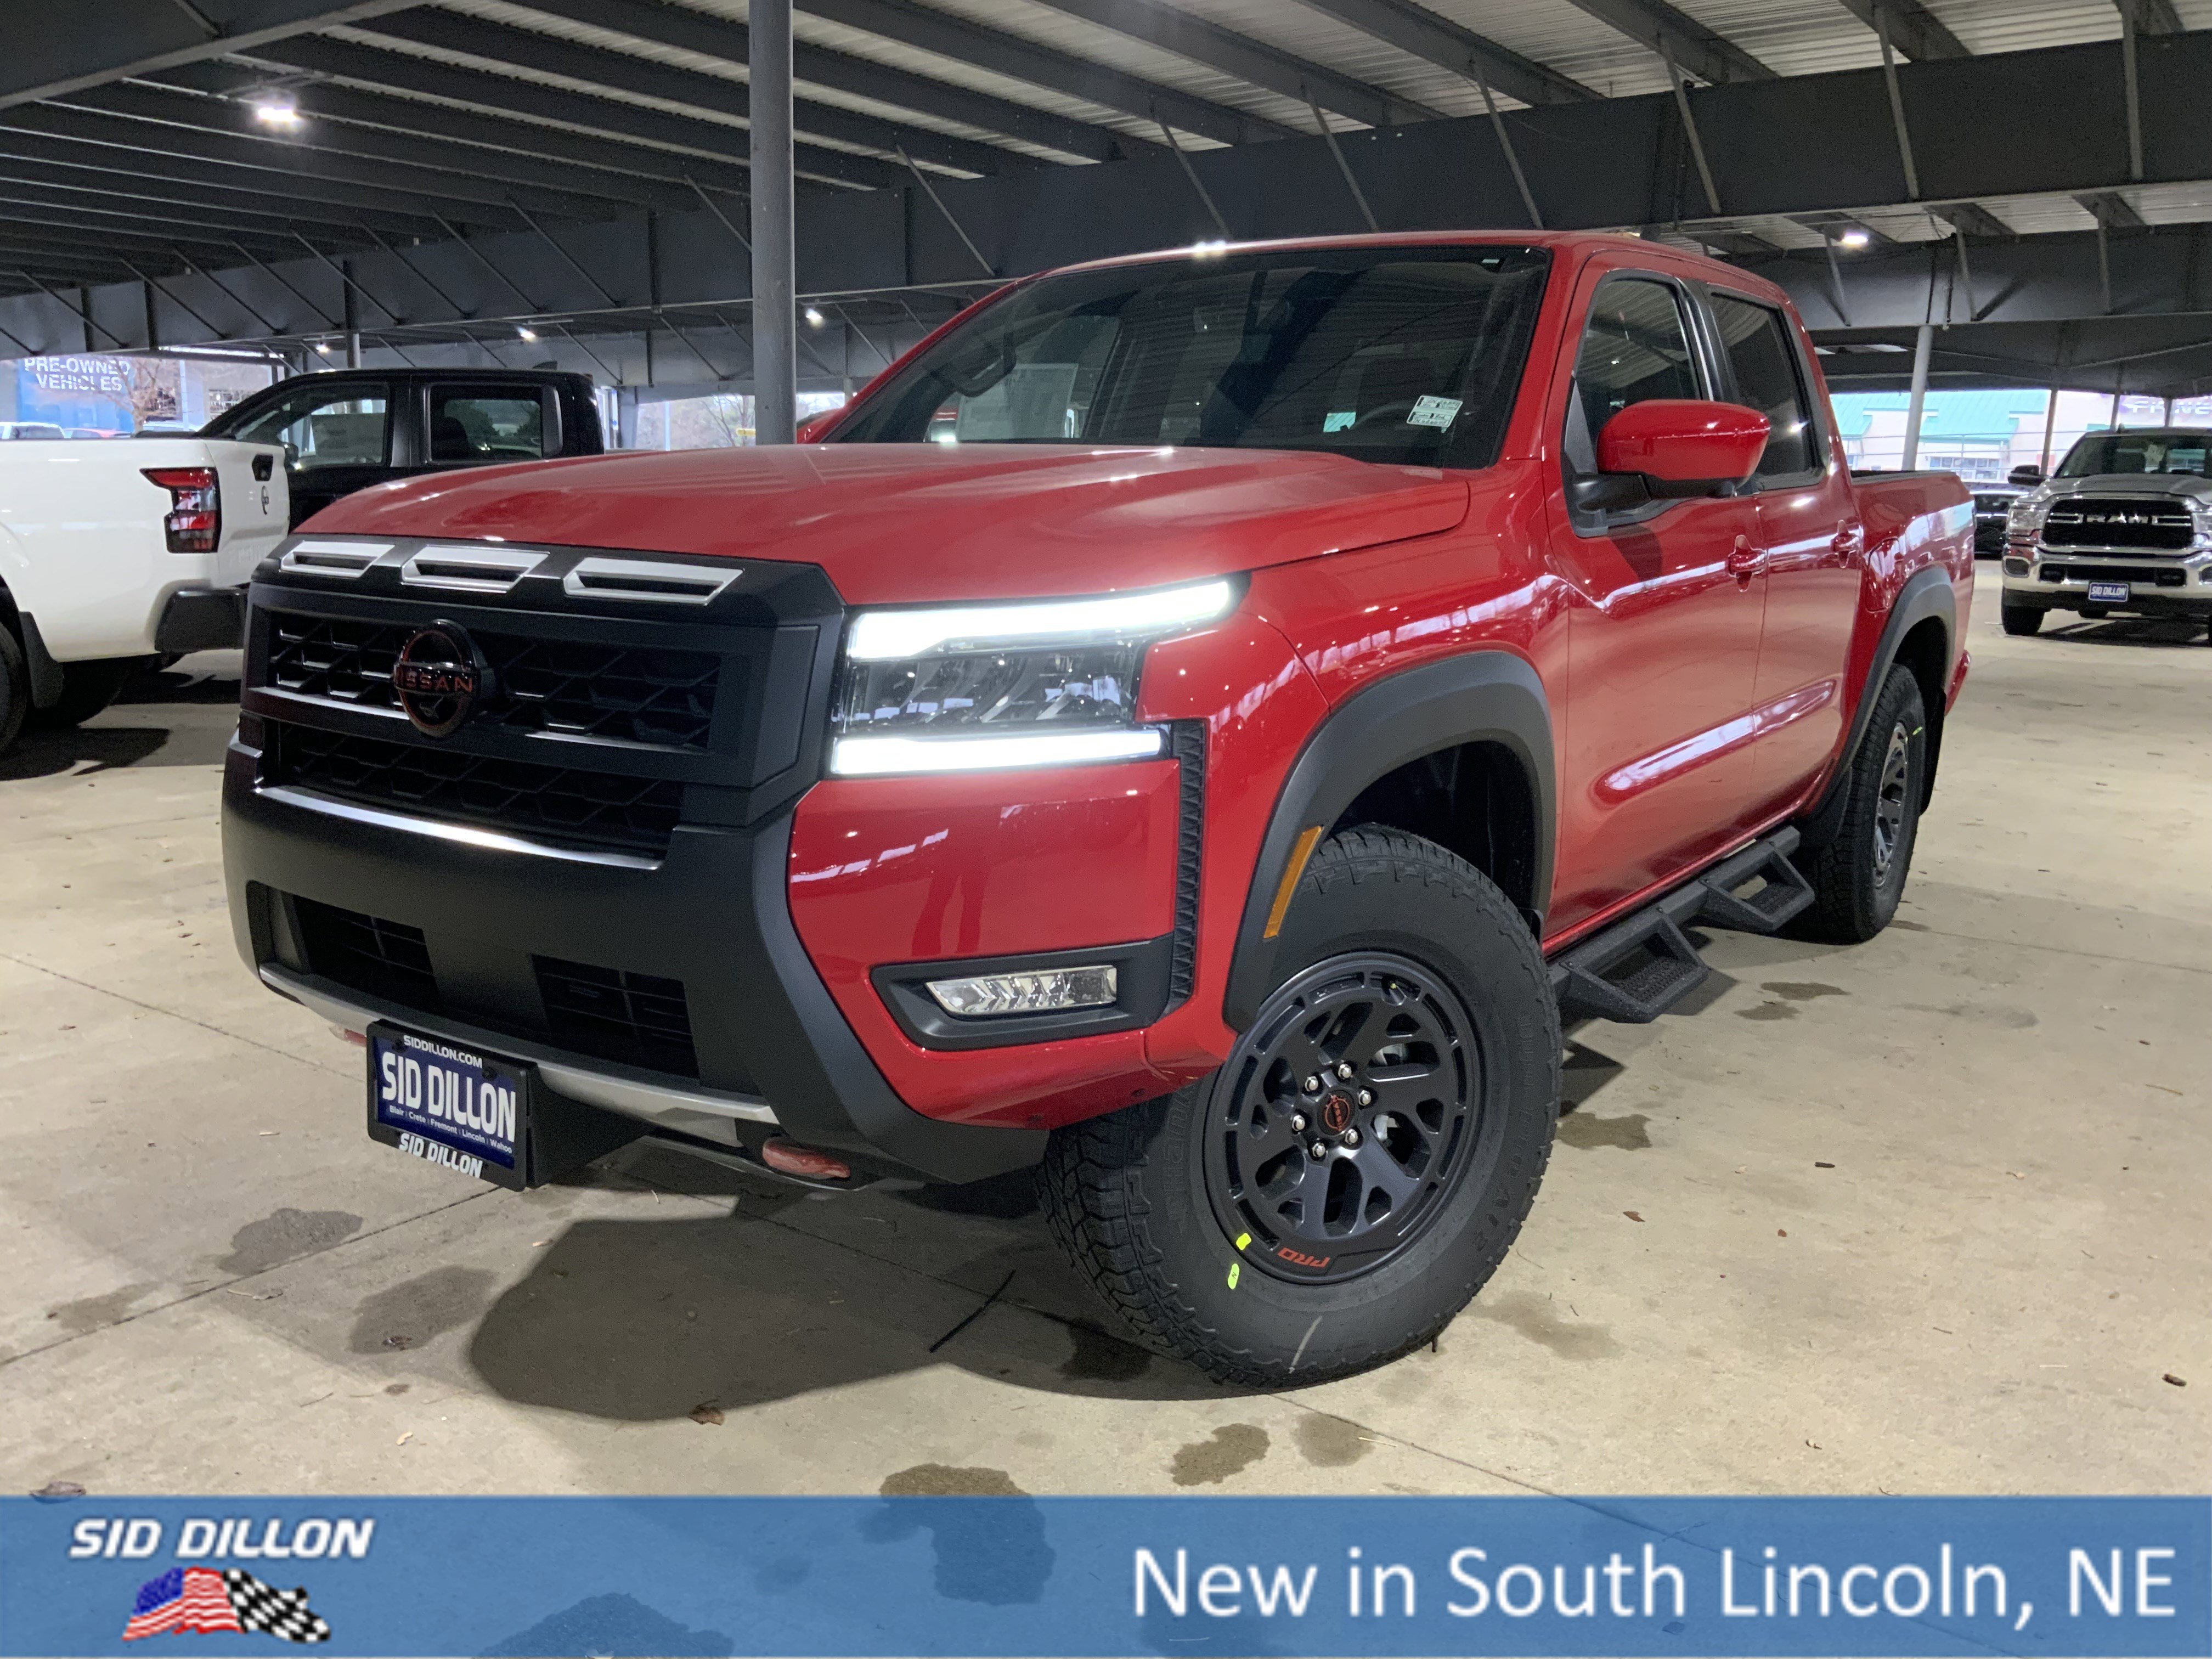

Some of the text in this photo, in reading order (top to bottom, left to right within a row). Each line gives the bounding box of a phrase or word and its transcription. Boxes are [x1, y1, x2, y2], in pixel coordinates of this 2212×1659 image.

[24, 357, 131, 375] PRE-OWNED
[36, 373, 122, 391] VEHICLES
[2086, 514, 2148, 523] RAM
[403, 1035, 483, 1069] SIDDILLON.COM
[382, 1052, 516, 1143] SID DILLON
[389, 1105, 512, 1154] Blair Crete Fremont Lincoln Wahoo
[399, 1133, 483, 1178] SID DILLON
[1277, 1247, 1330, 1268] PRO
